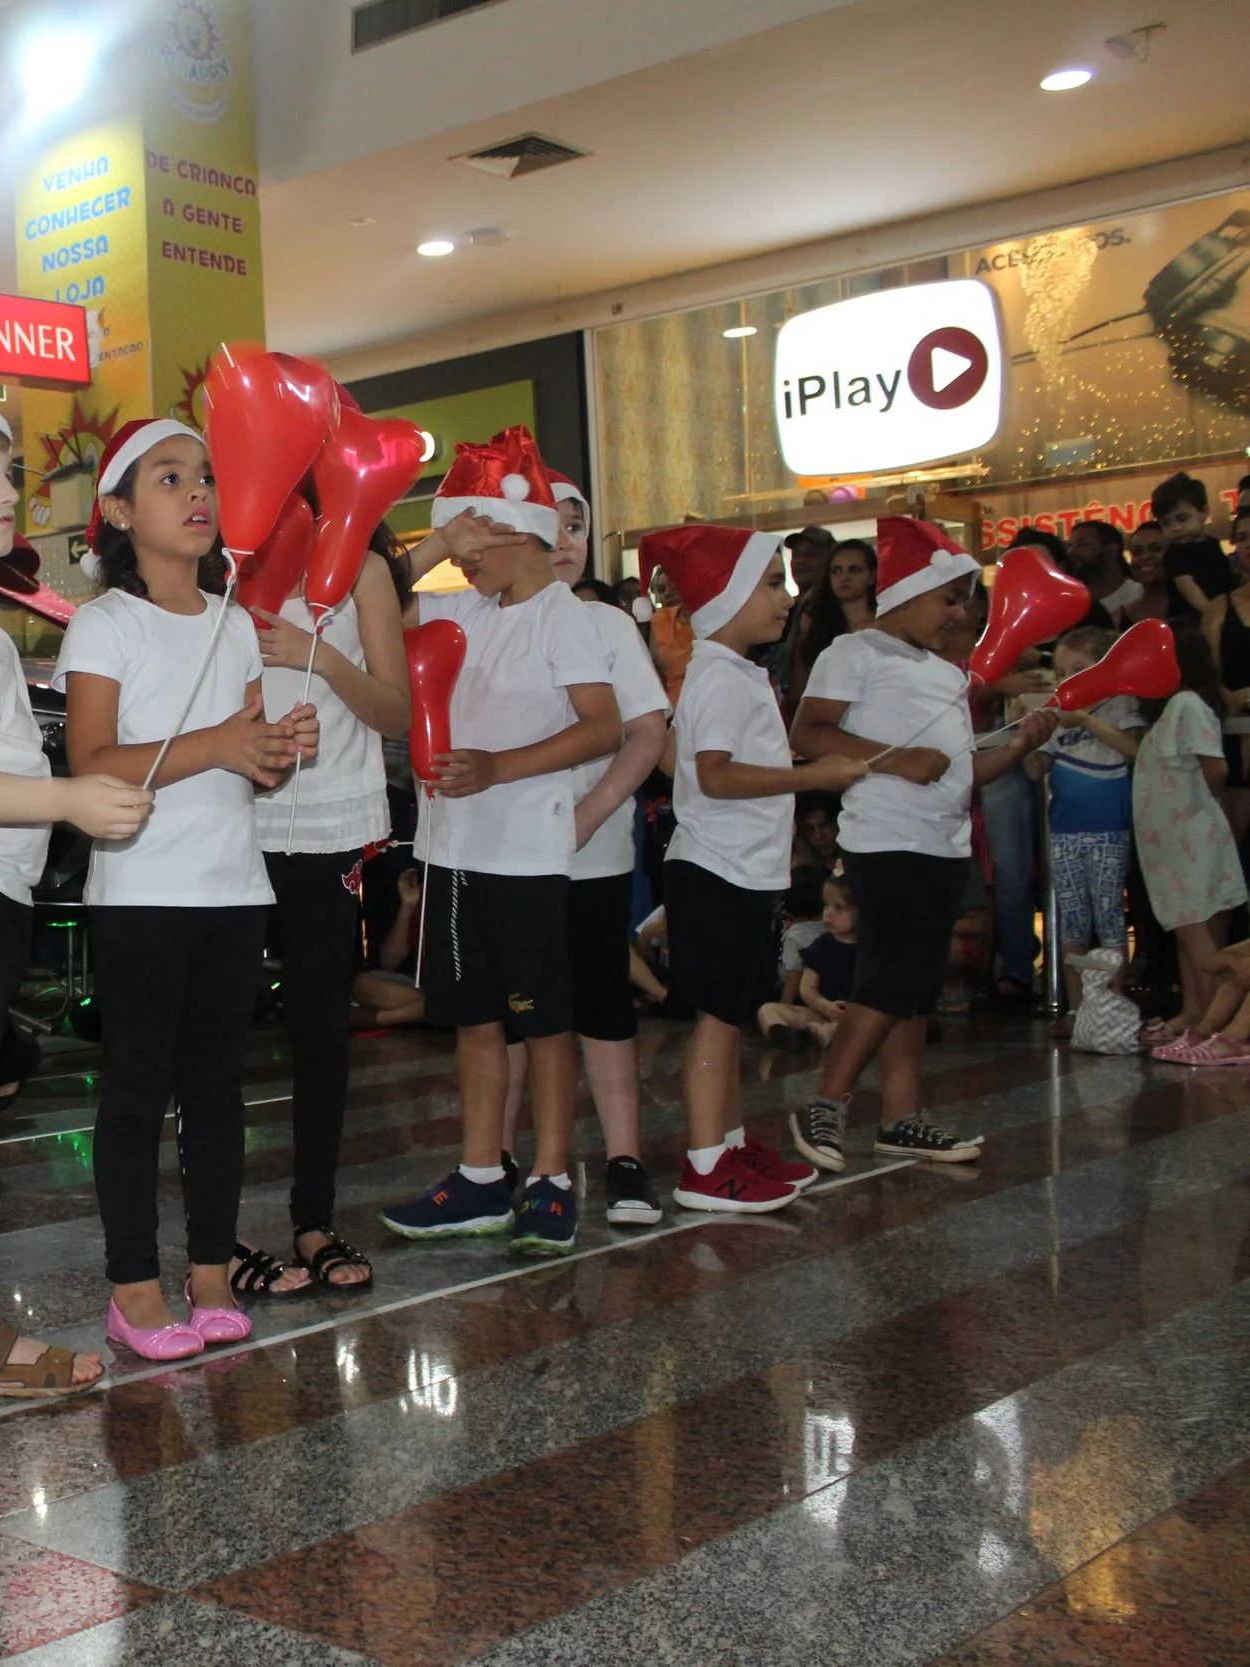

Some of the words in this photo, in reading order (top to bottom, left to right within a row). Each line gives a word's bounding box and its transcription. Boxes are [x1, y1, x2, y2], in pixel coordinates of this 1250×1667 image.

[43, 156, 109, 193] VENHA
[144, 150, 169, 173] DE
[25, 187, 131, 240] CONHECER
[163, 198, 175, 217] A
[182, 204, 242, 234] GENTE
[42, 235, 109, 273] NOSSA
[162, 241, 247, 276] ENTENDE
[783, 370, 902, 418] iPlay
